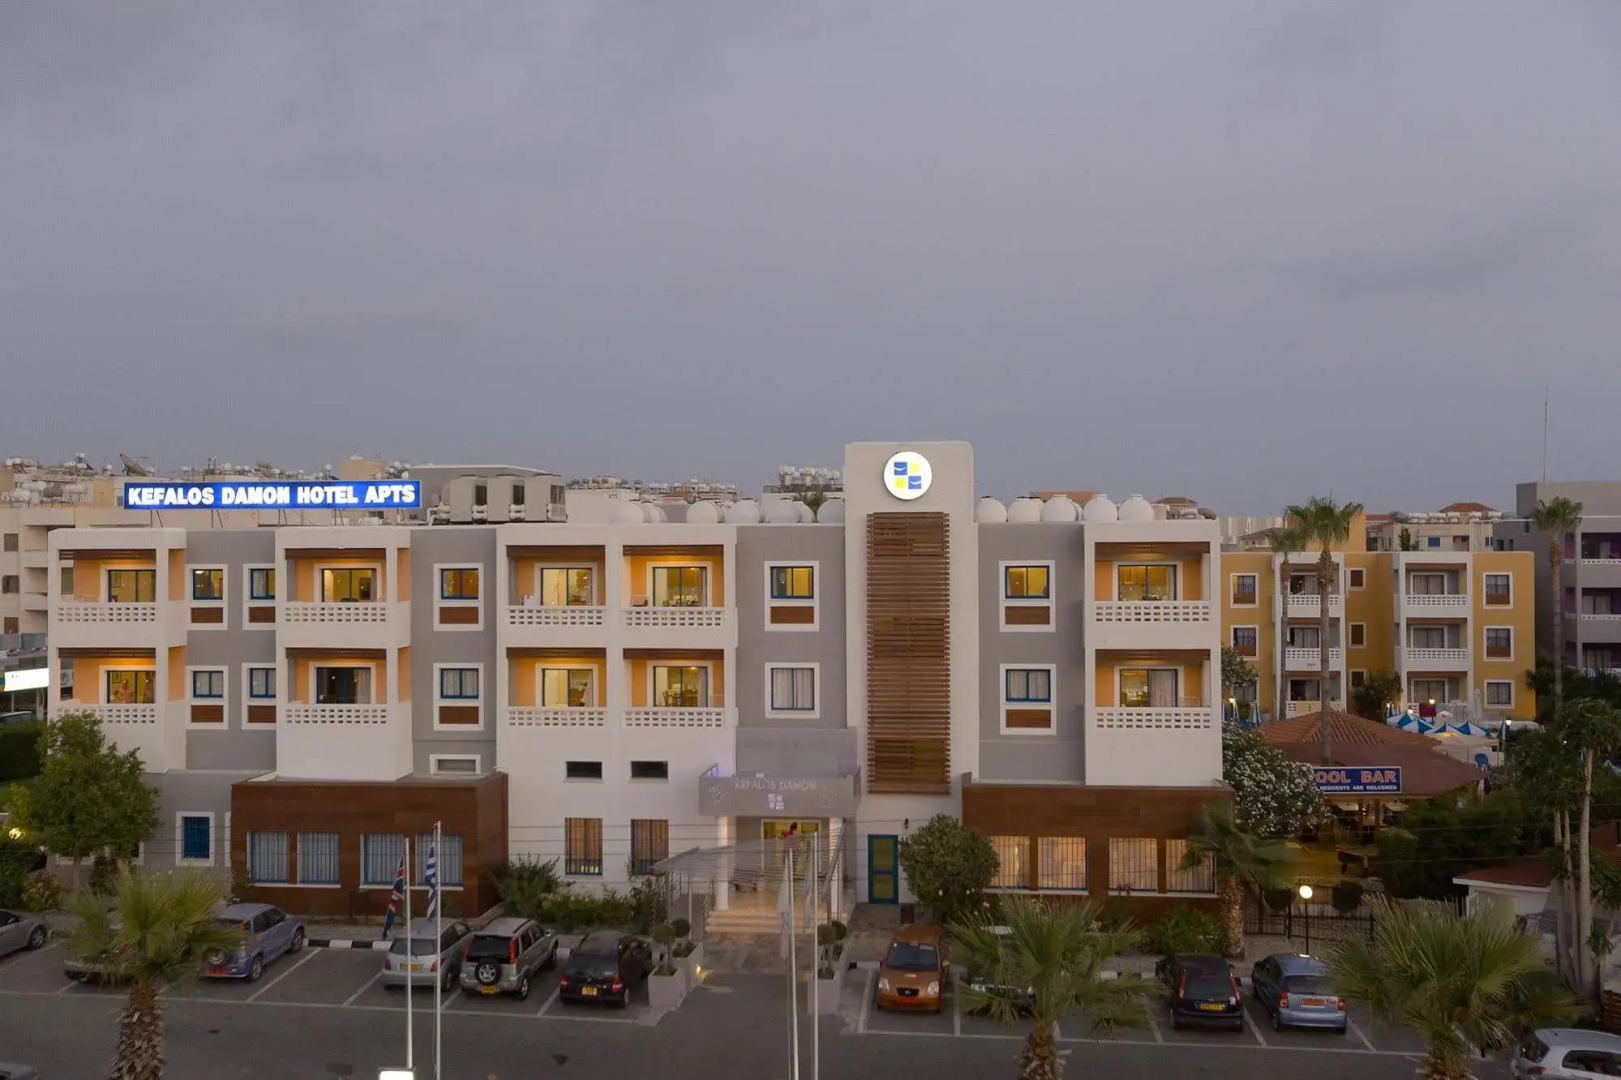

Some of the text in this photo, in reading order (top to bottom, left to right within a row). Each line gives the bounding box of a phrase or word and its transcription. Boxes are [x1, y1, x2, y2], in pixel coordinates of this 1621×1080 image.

[128, 484, 416, 505] KEFALOS DAMON HOTEL APTS
[1315, 771, 1396, 783] OOL BAR
[735, 780, 816, 790] KEFALOS DAMON
